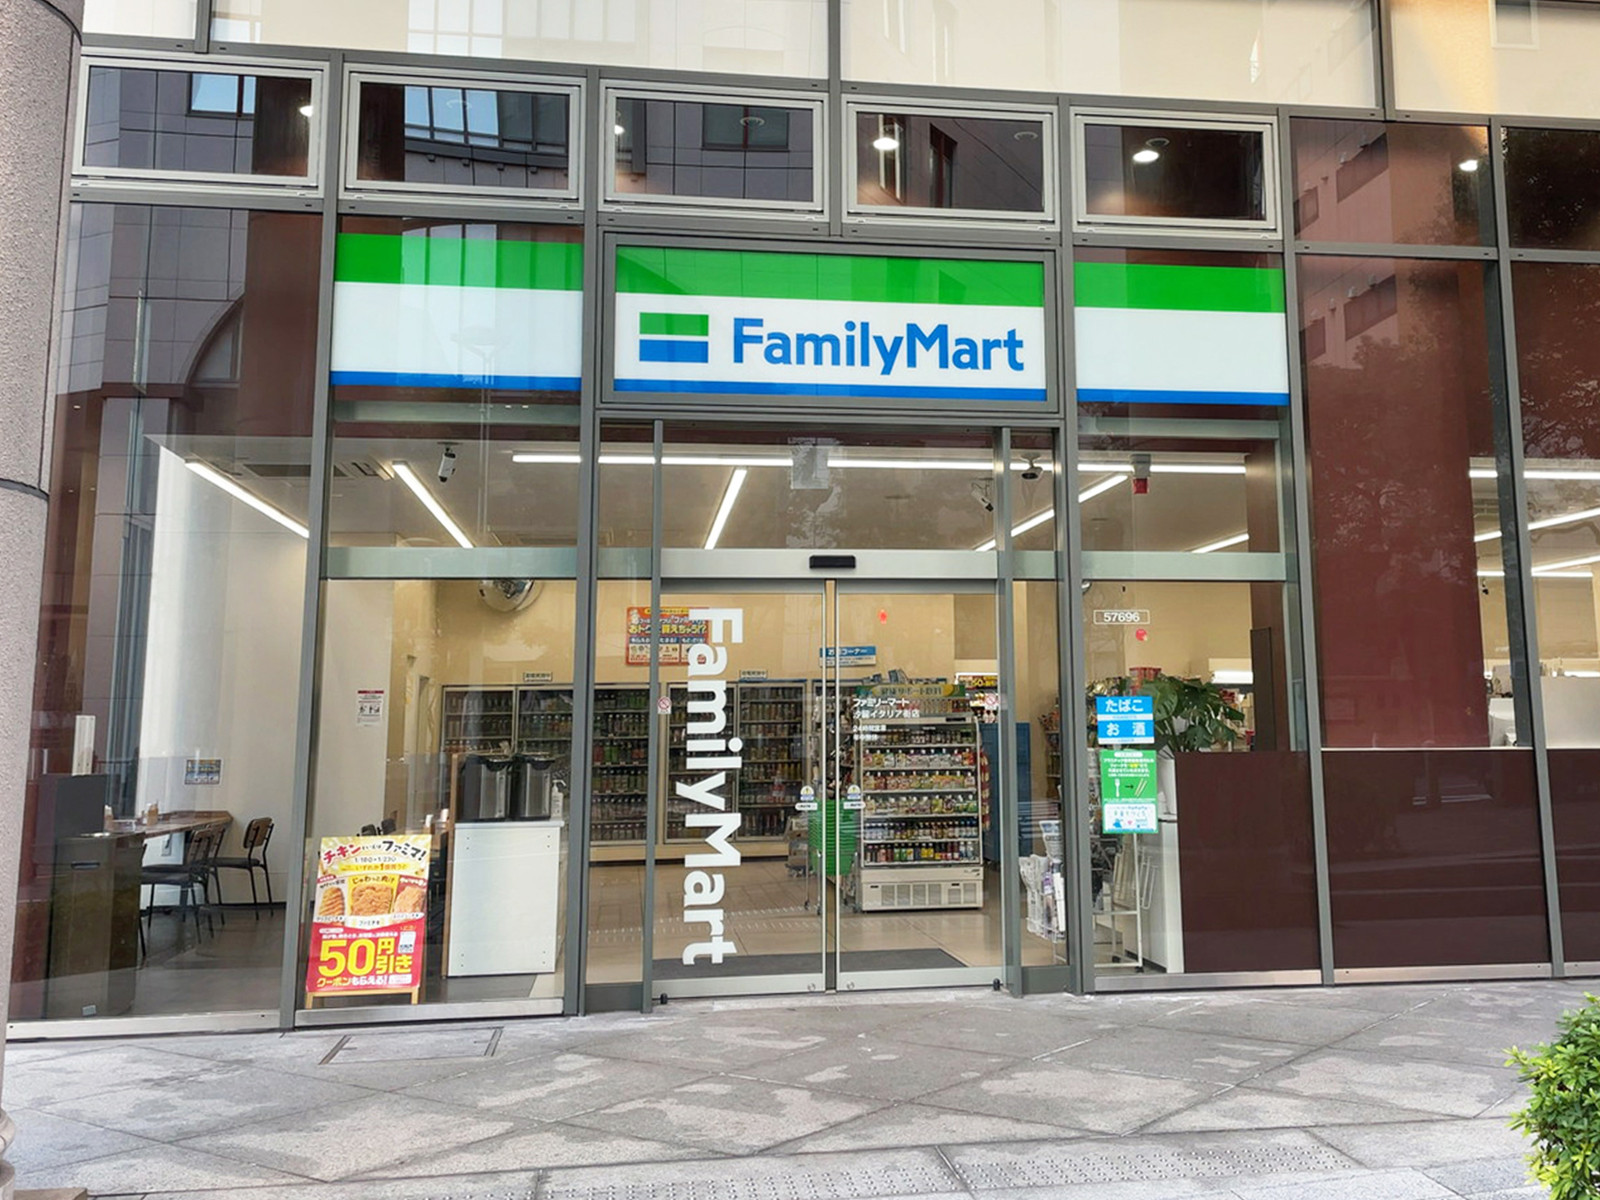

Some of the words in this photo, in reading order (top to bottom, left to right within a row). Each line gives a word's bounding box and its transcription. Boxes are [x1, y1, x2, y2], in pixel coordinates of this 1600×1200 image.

[733, 317, 1025, 376] FamilyMart
[1103, 611, 1140, 623] 57696
[853, 697, 910, 709] ファミリーマート
[1105, 698, 1144, 713] たばこ
[675, 608, 743, 965] FamilyMart
[316, 975, 388, 988] クーポンもらえる!
